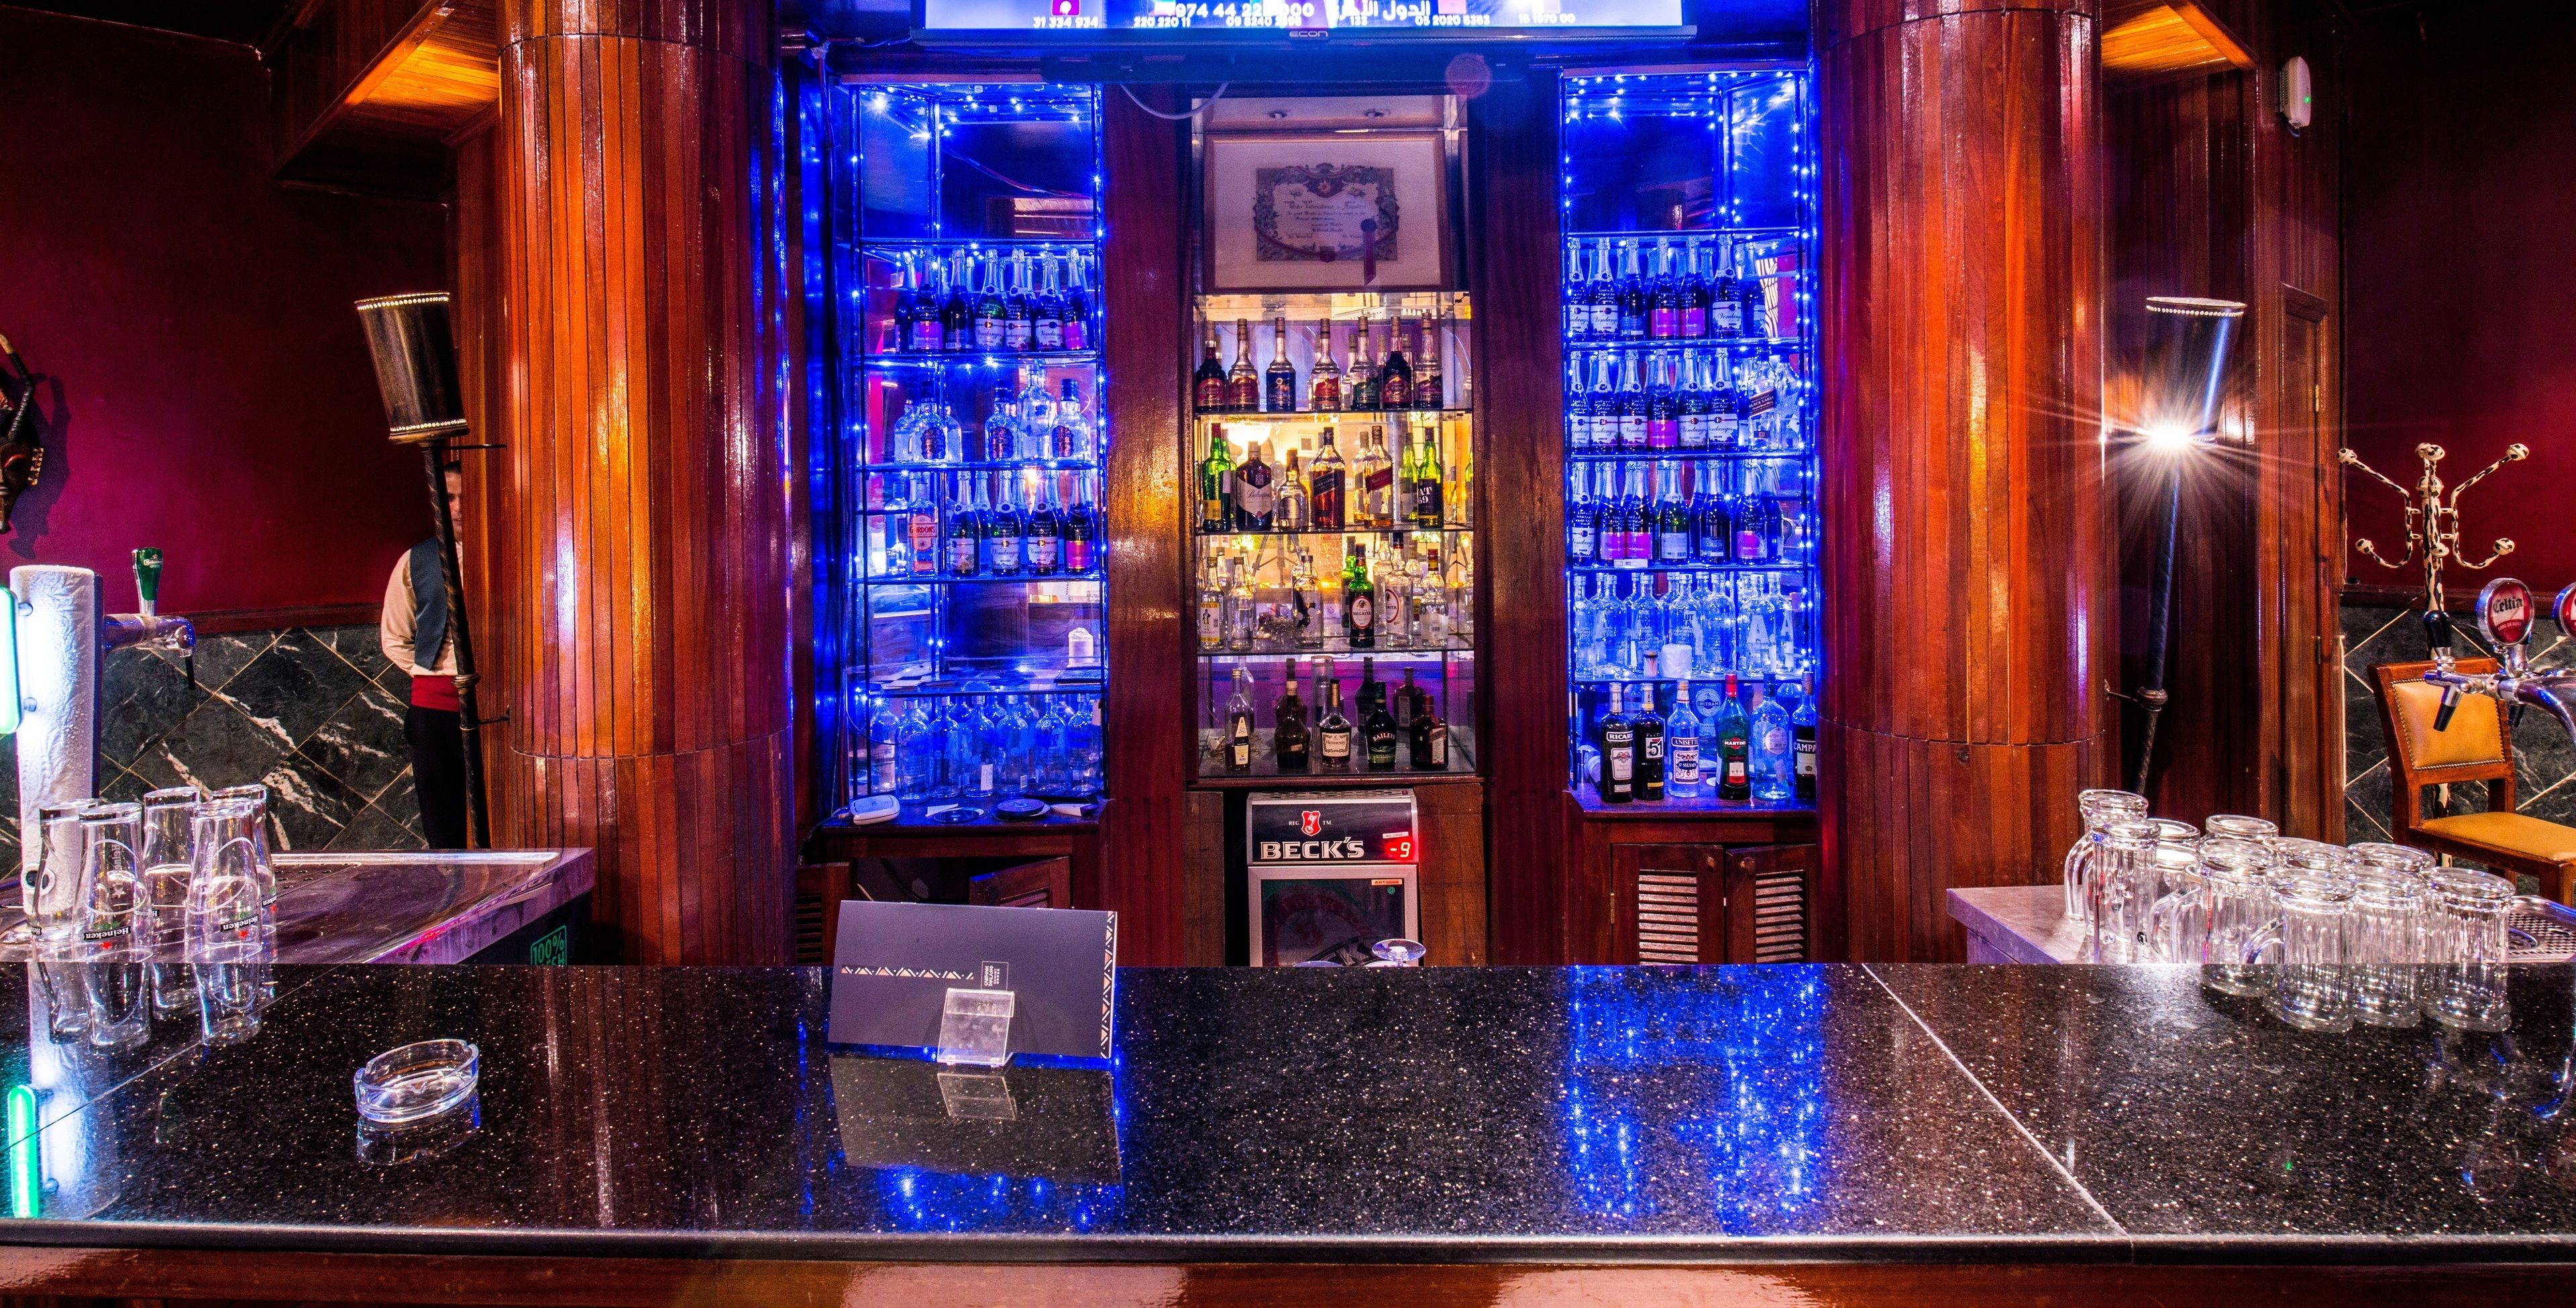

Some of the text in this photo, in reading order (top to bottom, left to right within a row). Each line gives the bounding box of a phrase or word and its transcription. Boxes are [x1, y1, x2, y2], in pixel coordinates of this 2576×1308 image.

[1181, 16, 1191, 28] 11
[2493, 596, 2523, 613] Celtia
[1649, 739, 1662, 756] 51
[1260, 837, 1364, 859] BECK'S
[223, 916, 259, 930] Heineken
[85, 926, 129, 940] Heineken
[533, 932, 565, 965] 100%
